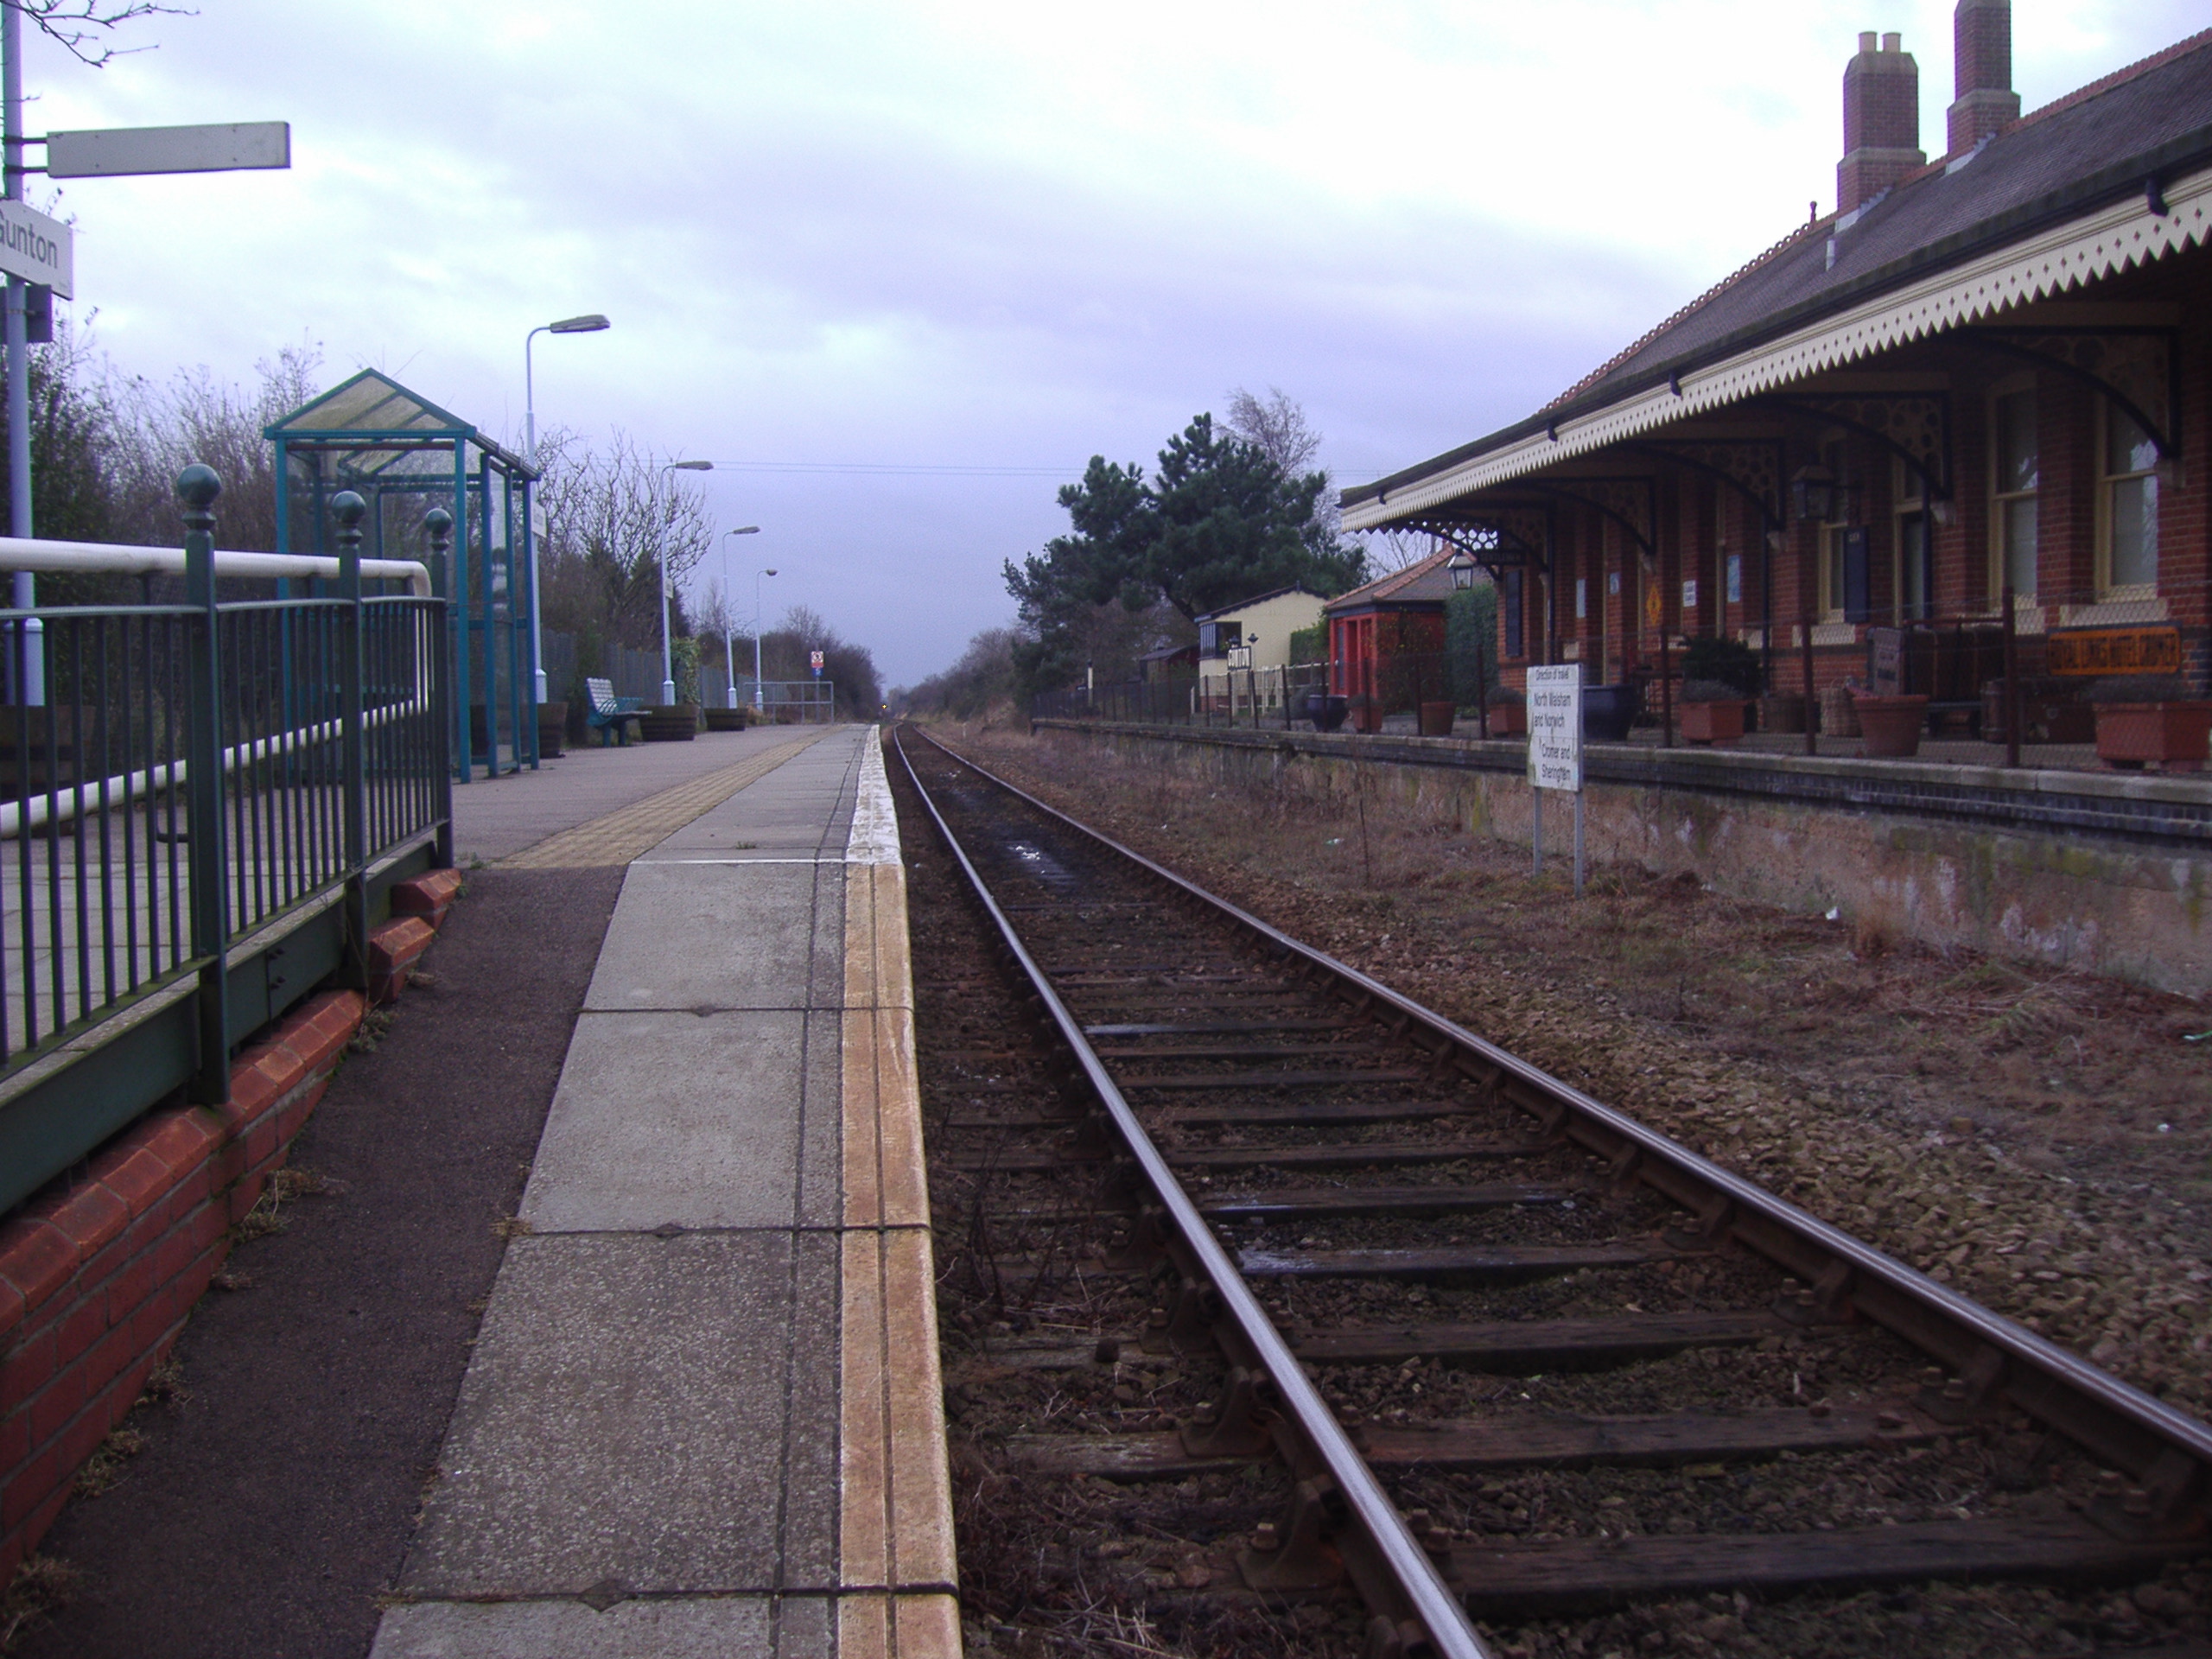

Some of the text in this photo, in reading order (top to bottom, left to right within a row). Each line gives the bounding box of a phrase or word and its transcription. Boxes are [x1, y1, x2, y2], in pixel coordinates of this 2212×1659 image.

[1535, 669, 1552, 680] Direction
[1558, 667, 1569, 679] travel
[1534, 692, 1571, 707] North Walsham
[1534, 713, 1565, 728] and Norwich
[1541, 743, 1571, 760] Cromer and
[1541, 764, 1571, 783] Sheringham
